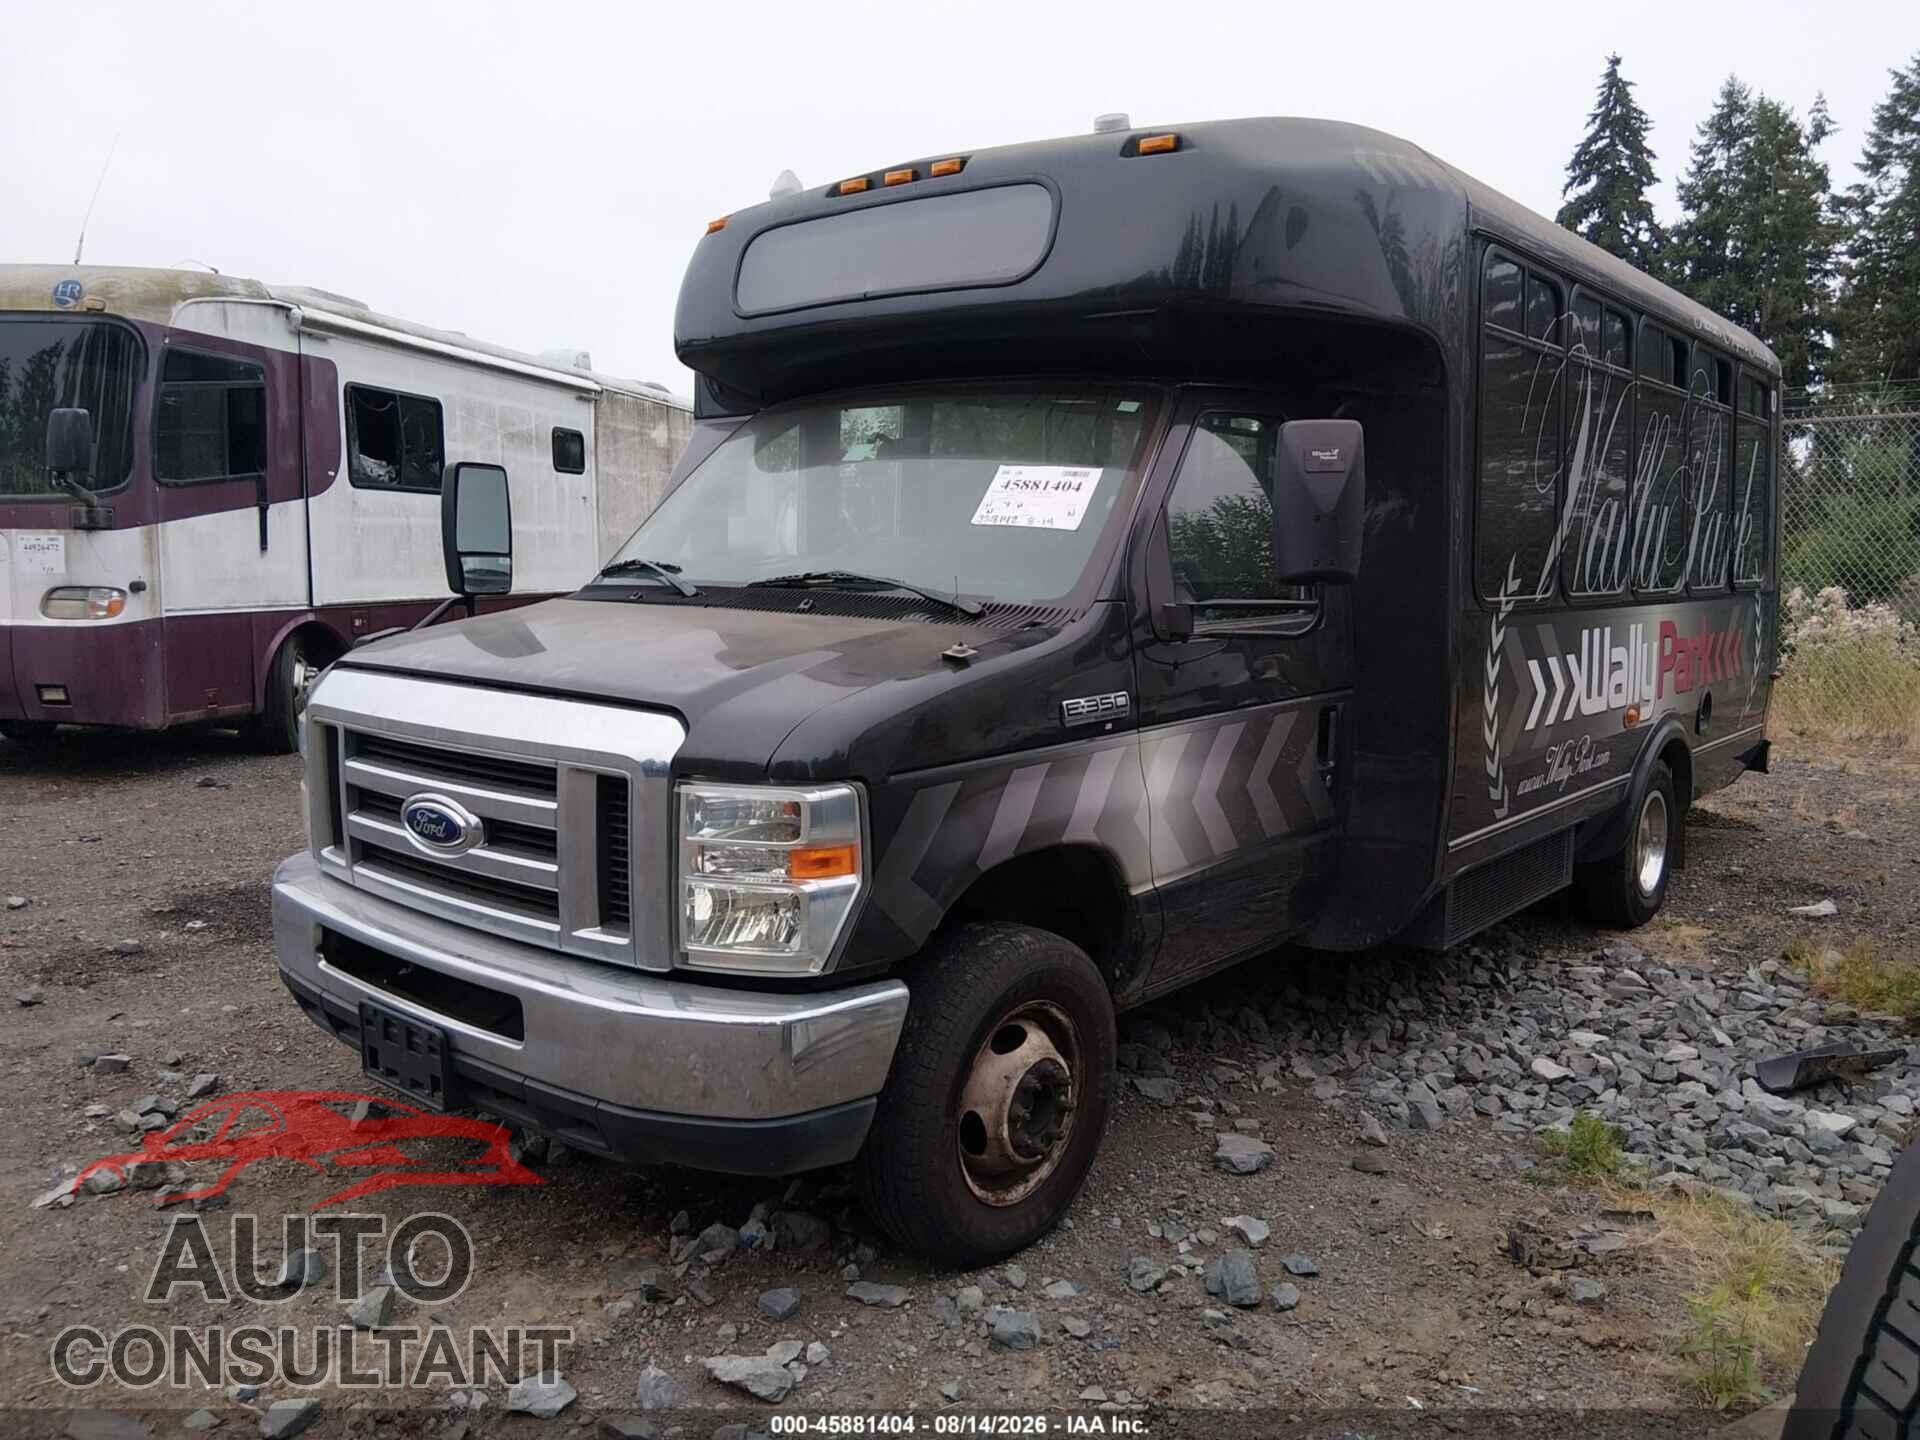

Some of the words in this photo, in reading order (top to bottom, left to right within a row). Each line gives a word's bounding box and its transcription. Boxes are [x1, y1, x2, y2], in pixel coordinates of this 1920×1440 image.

[56, 283, 80, 297] HR
[1000, 479, 1083, 492] 45881404
[413, 809, 447, 838] Ford
